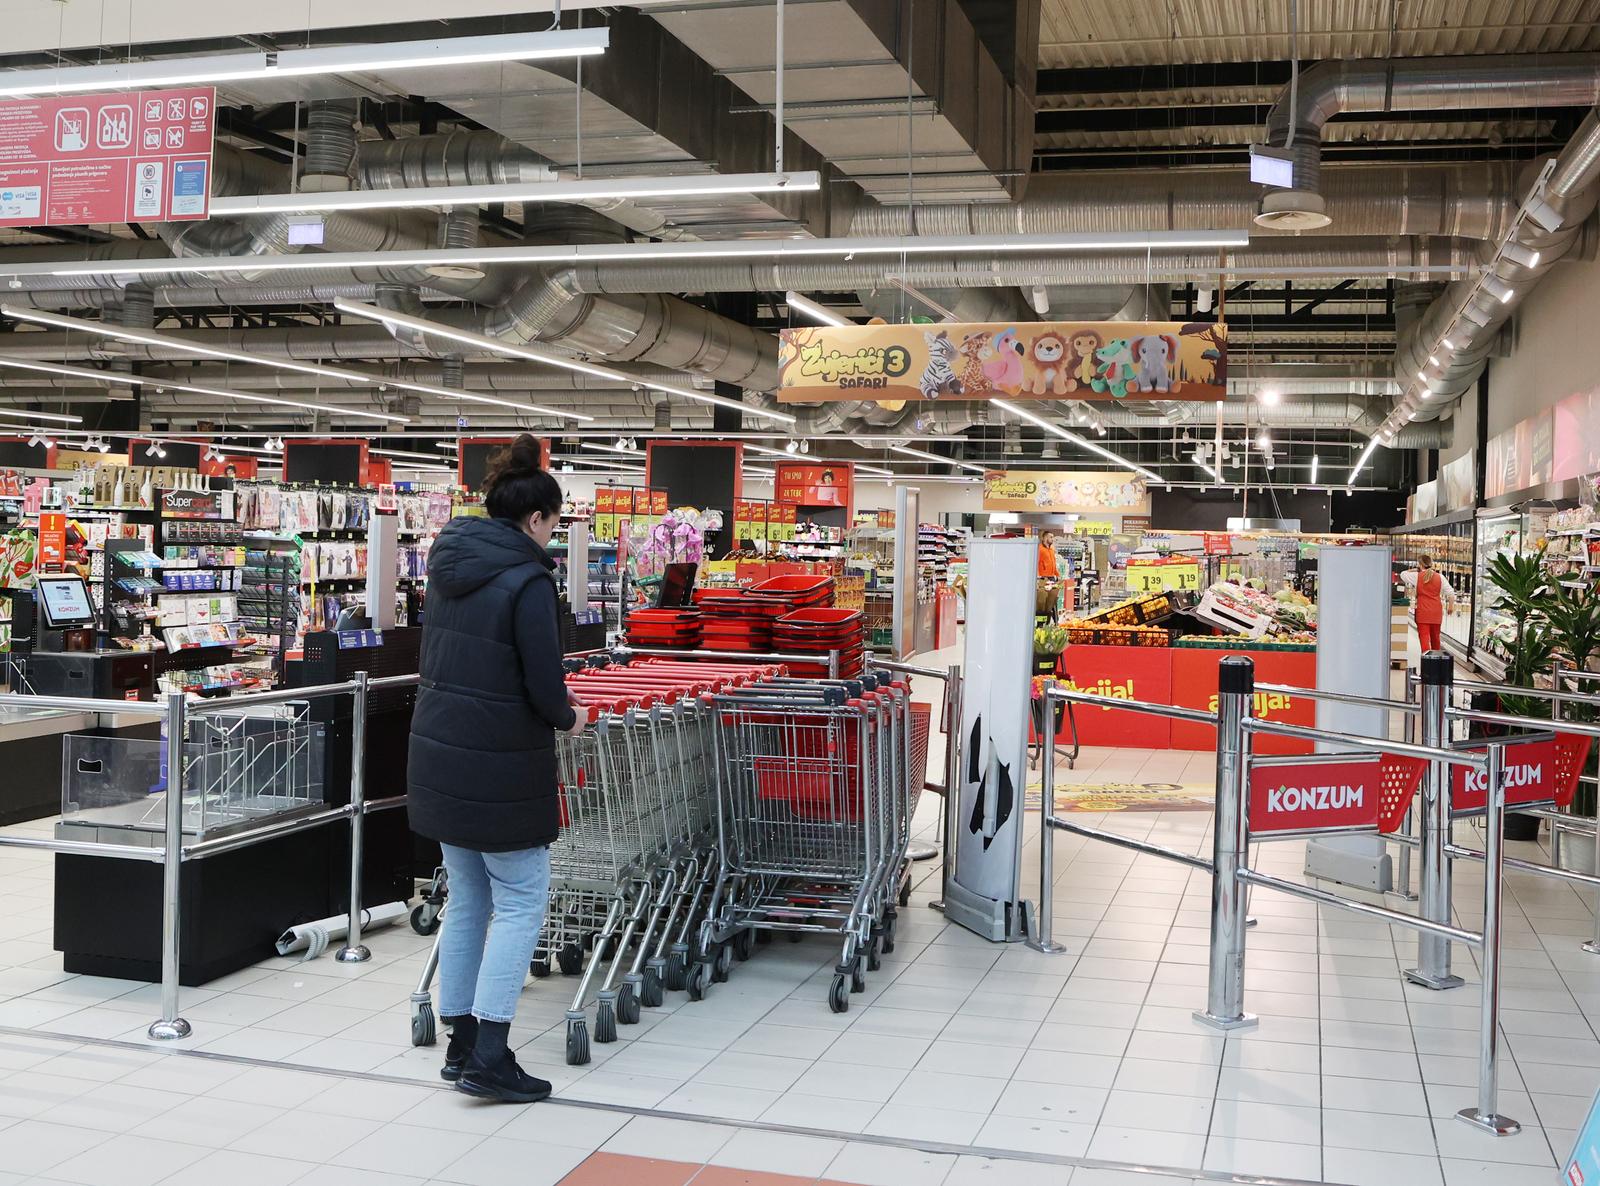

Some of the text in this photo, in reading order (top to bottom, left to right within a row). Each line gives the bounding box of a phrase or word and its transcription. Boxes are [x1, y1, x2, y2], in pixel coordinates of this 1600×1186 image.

[839, 376, 888, 389] SAFARI
[1464, 763, 1542, 792] KOZUM
[1268, 784, 1363, 813] KONZUM
